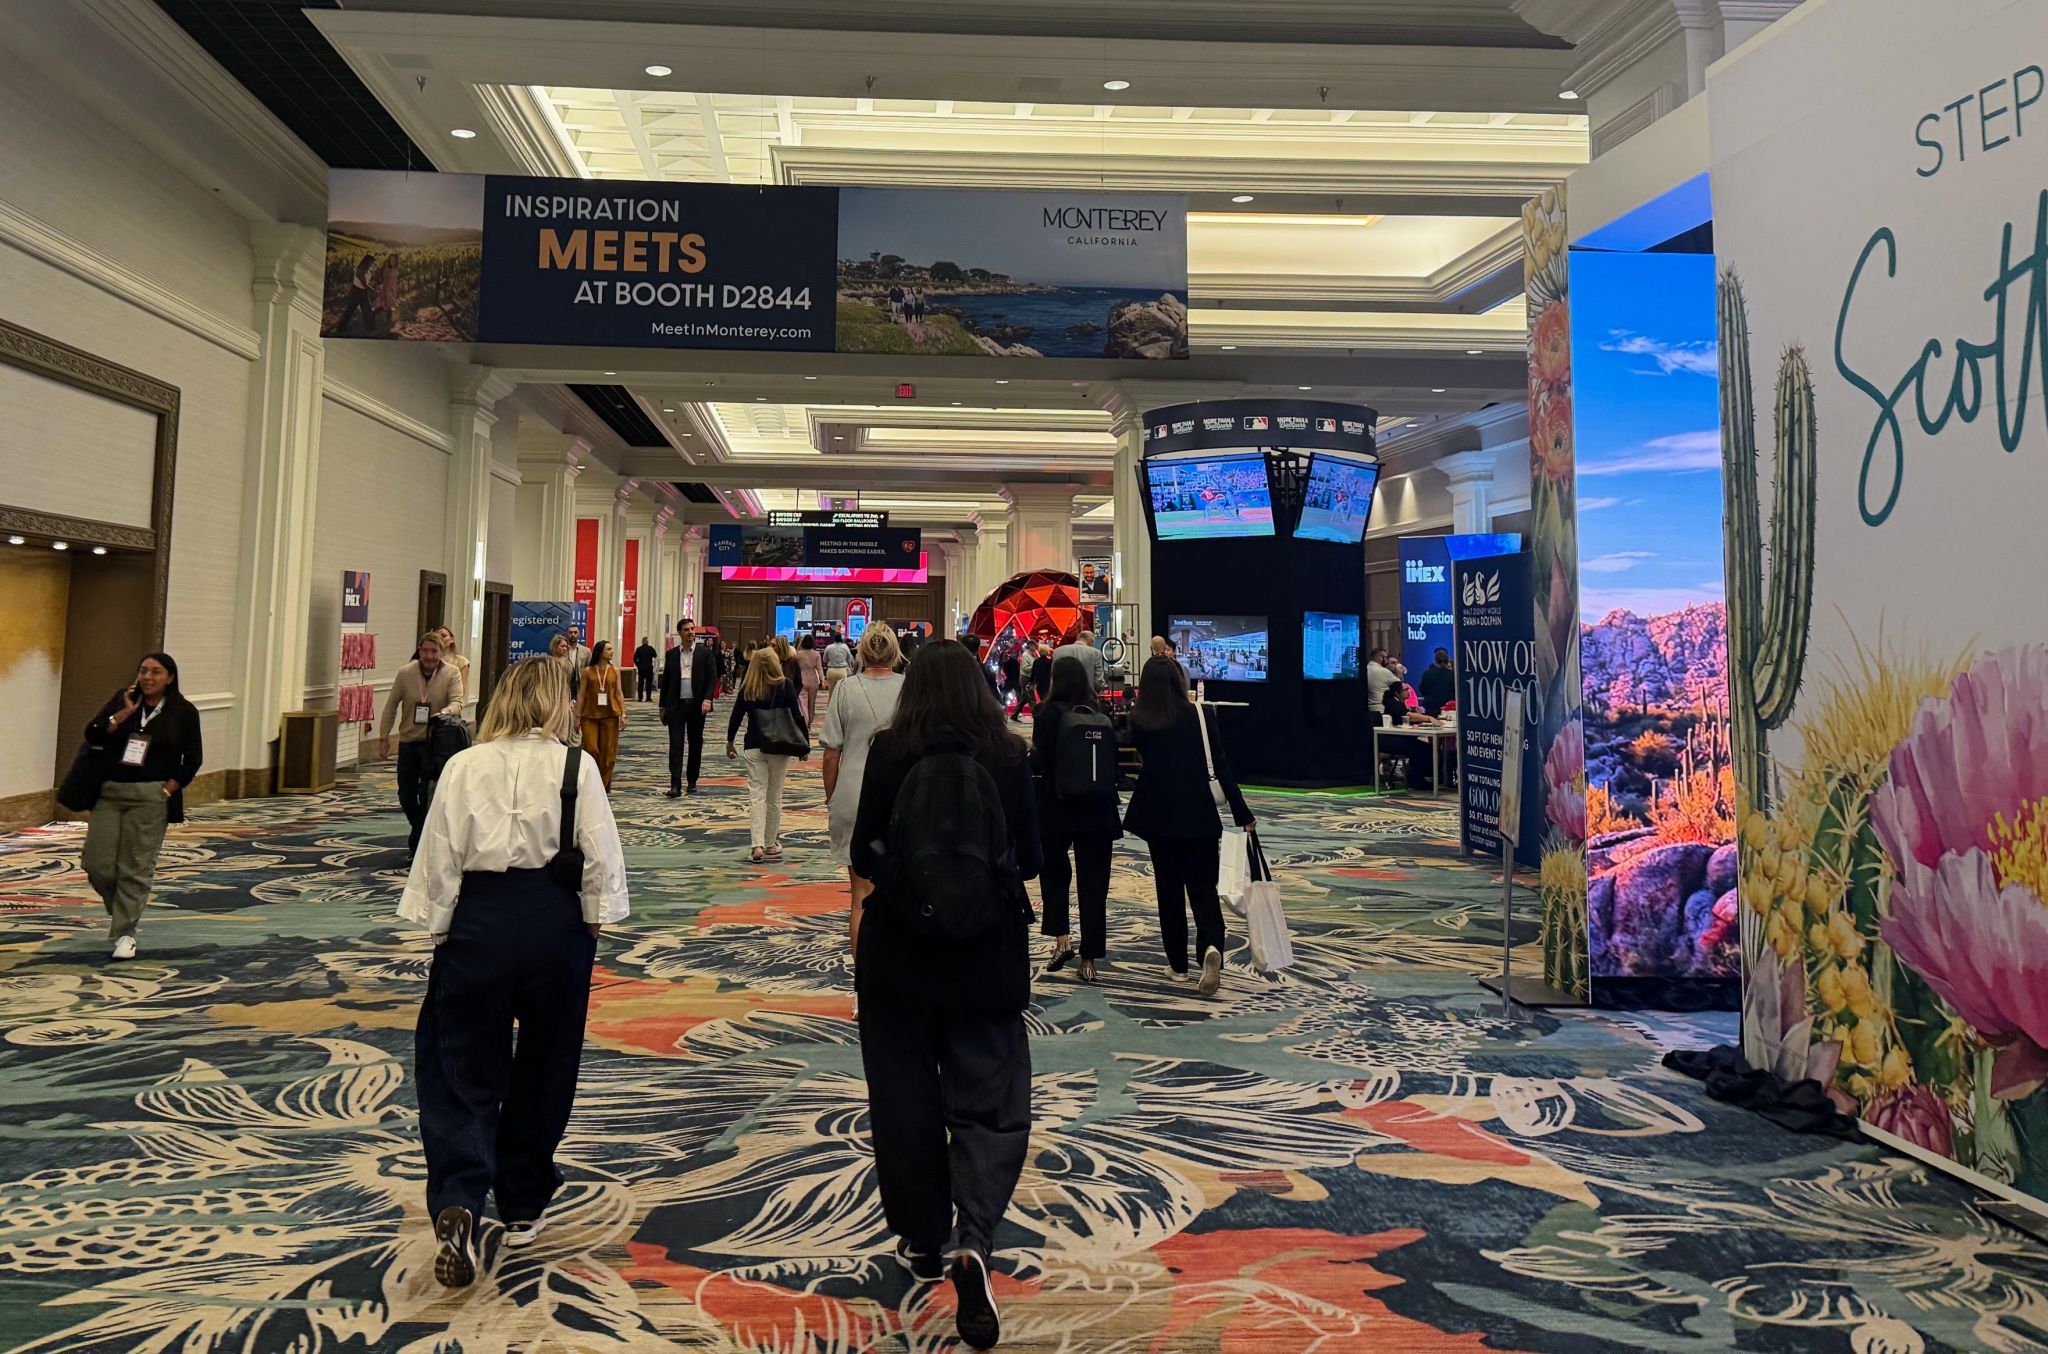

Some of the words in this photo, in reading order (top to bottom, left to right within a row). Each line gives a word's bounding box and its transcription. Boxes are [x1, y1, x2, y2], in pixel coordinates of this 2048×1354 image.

[1915, 65, 2044, 178] STEP
[505, 194, 680, 223] INSPIRATION
[1043, 207, 1168, 231] MONTEREY
[538, 228, 707, 274] MEETS
[1067, 236, 1138, 246] CALIFORNIA
[573, 281, 607, 305] AT
[615, 282, 715, 308] BOOTH
[722, 285, 812, 311] D2844
[651, 321, 812, 341] MeetInMonterey.com
[1408, 627, 1426, 640] hub
[1464, 640, 1510, 674] NOW
[1467, 730, 1475, 741] SQ
[1475, 731, 1482, 742] FT
[1482, 732, 1490, 743] OF
[1467, 745, 1479, 756] AND
[1479, 747, 1496, 760] EVENT
